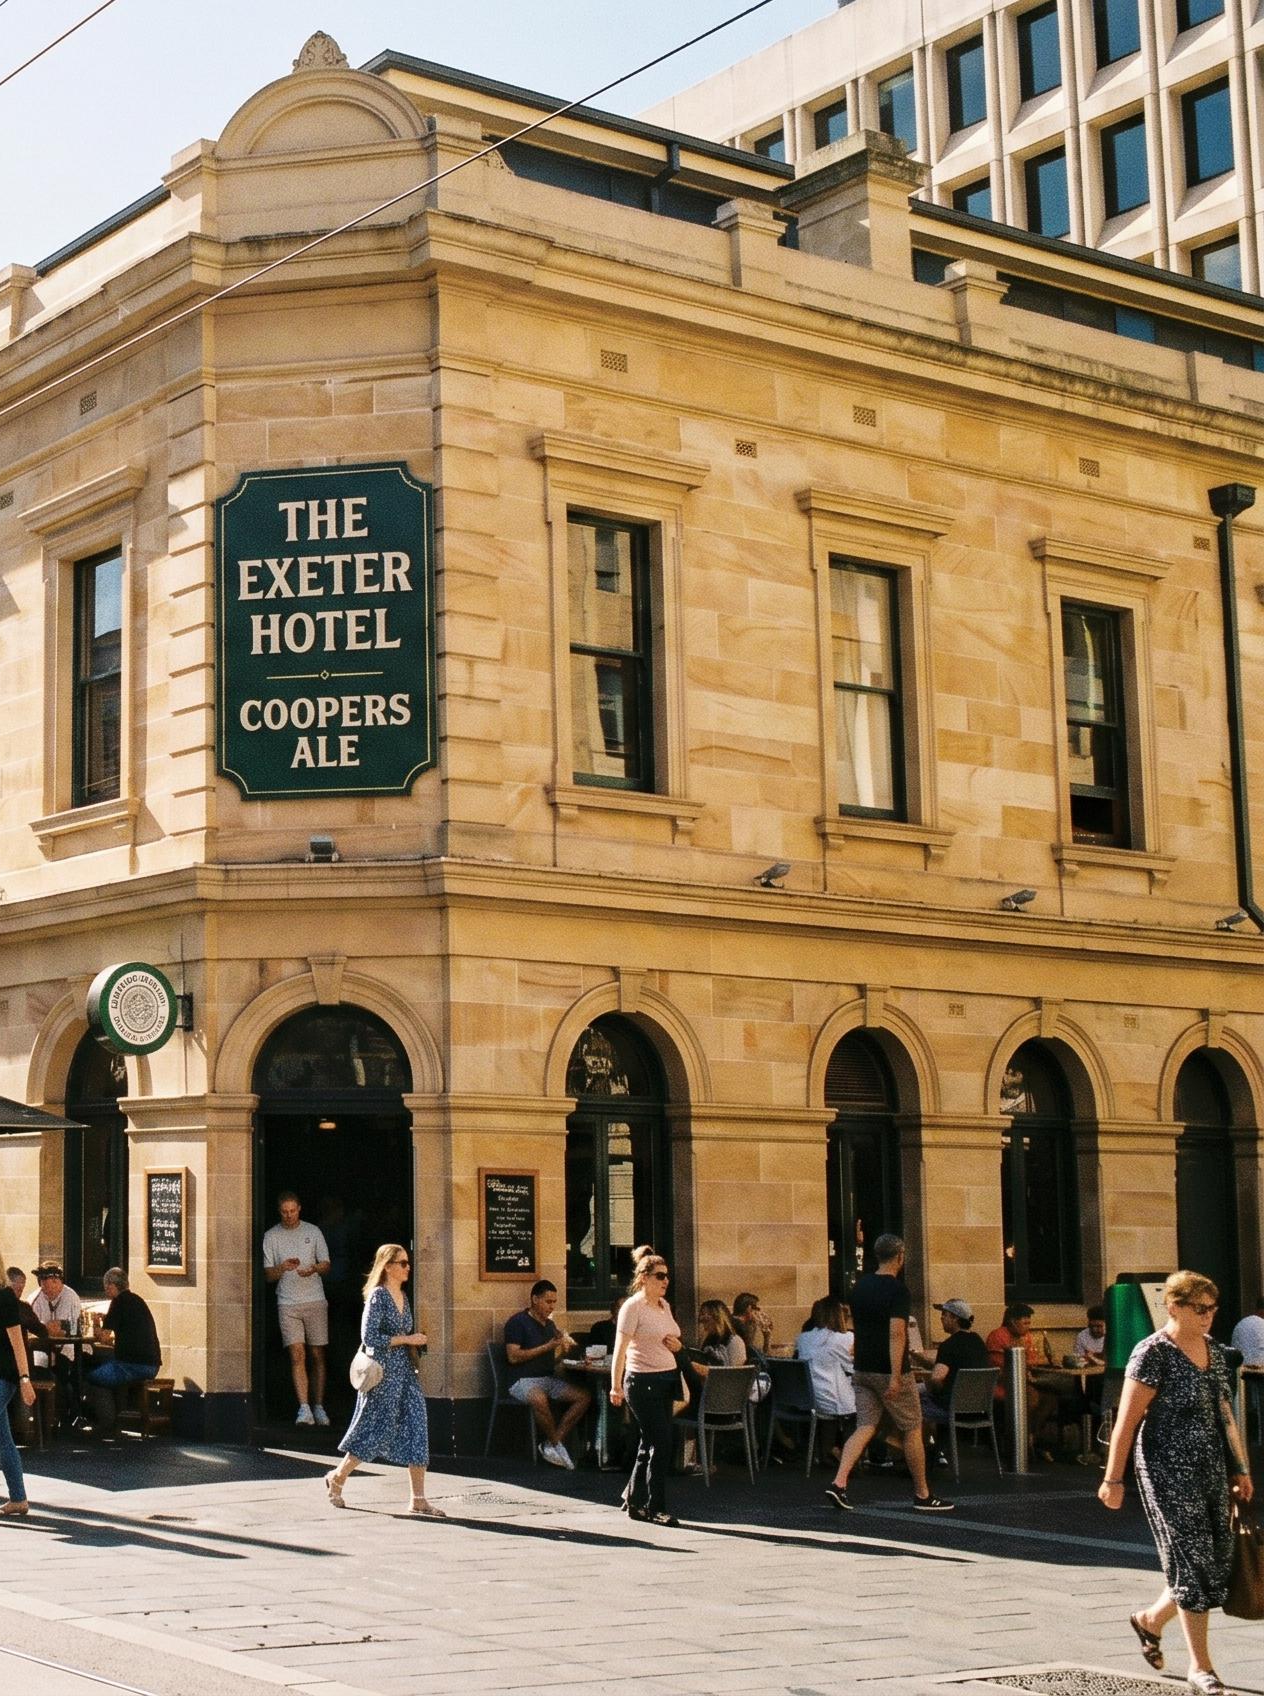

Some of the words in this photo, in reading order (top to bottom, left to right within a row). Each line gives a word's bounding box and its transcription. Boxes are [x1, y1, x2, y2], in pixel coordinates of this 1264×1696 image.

[278, 497, 368, 542] THE
[237, 551, 413, 600] EXETER
[250, 608, 401, 655] HOTEL
[239, 693, 412, 732] COOPERS
[290, 734, 361, 770] ALE
